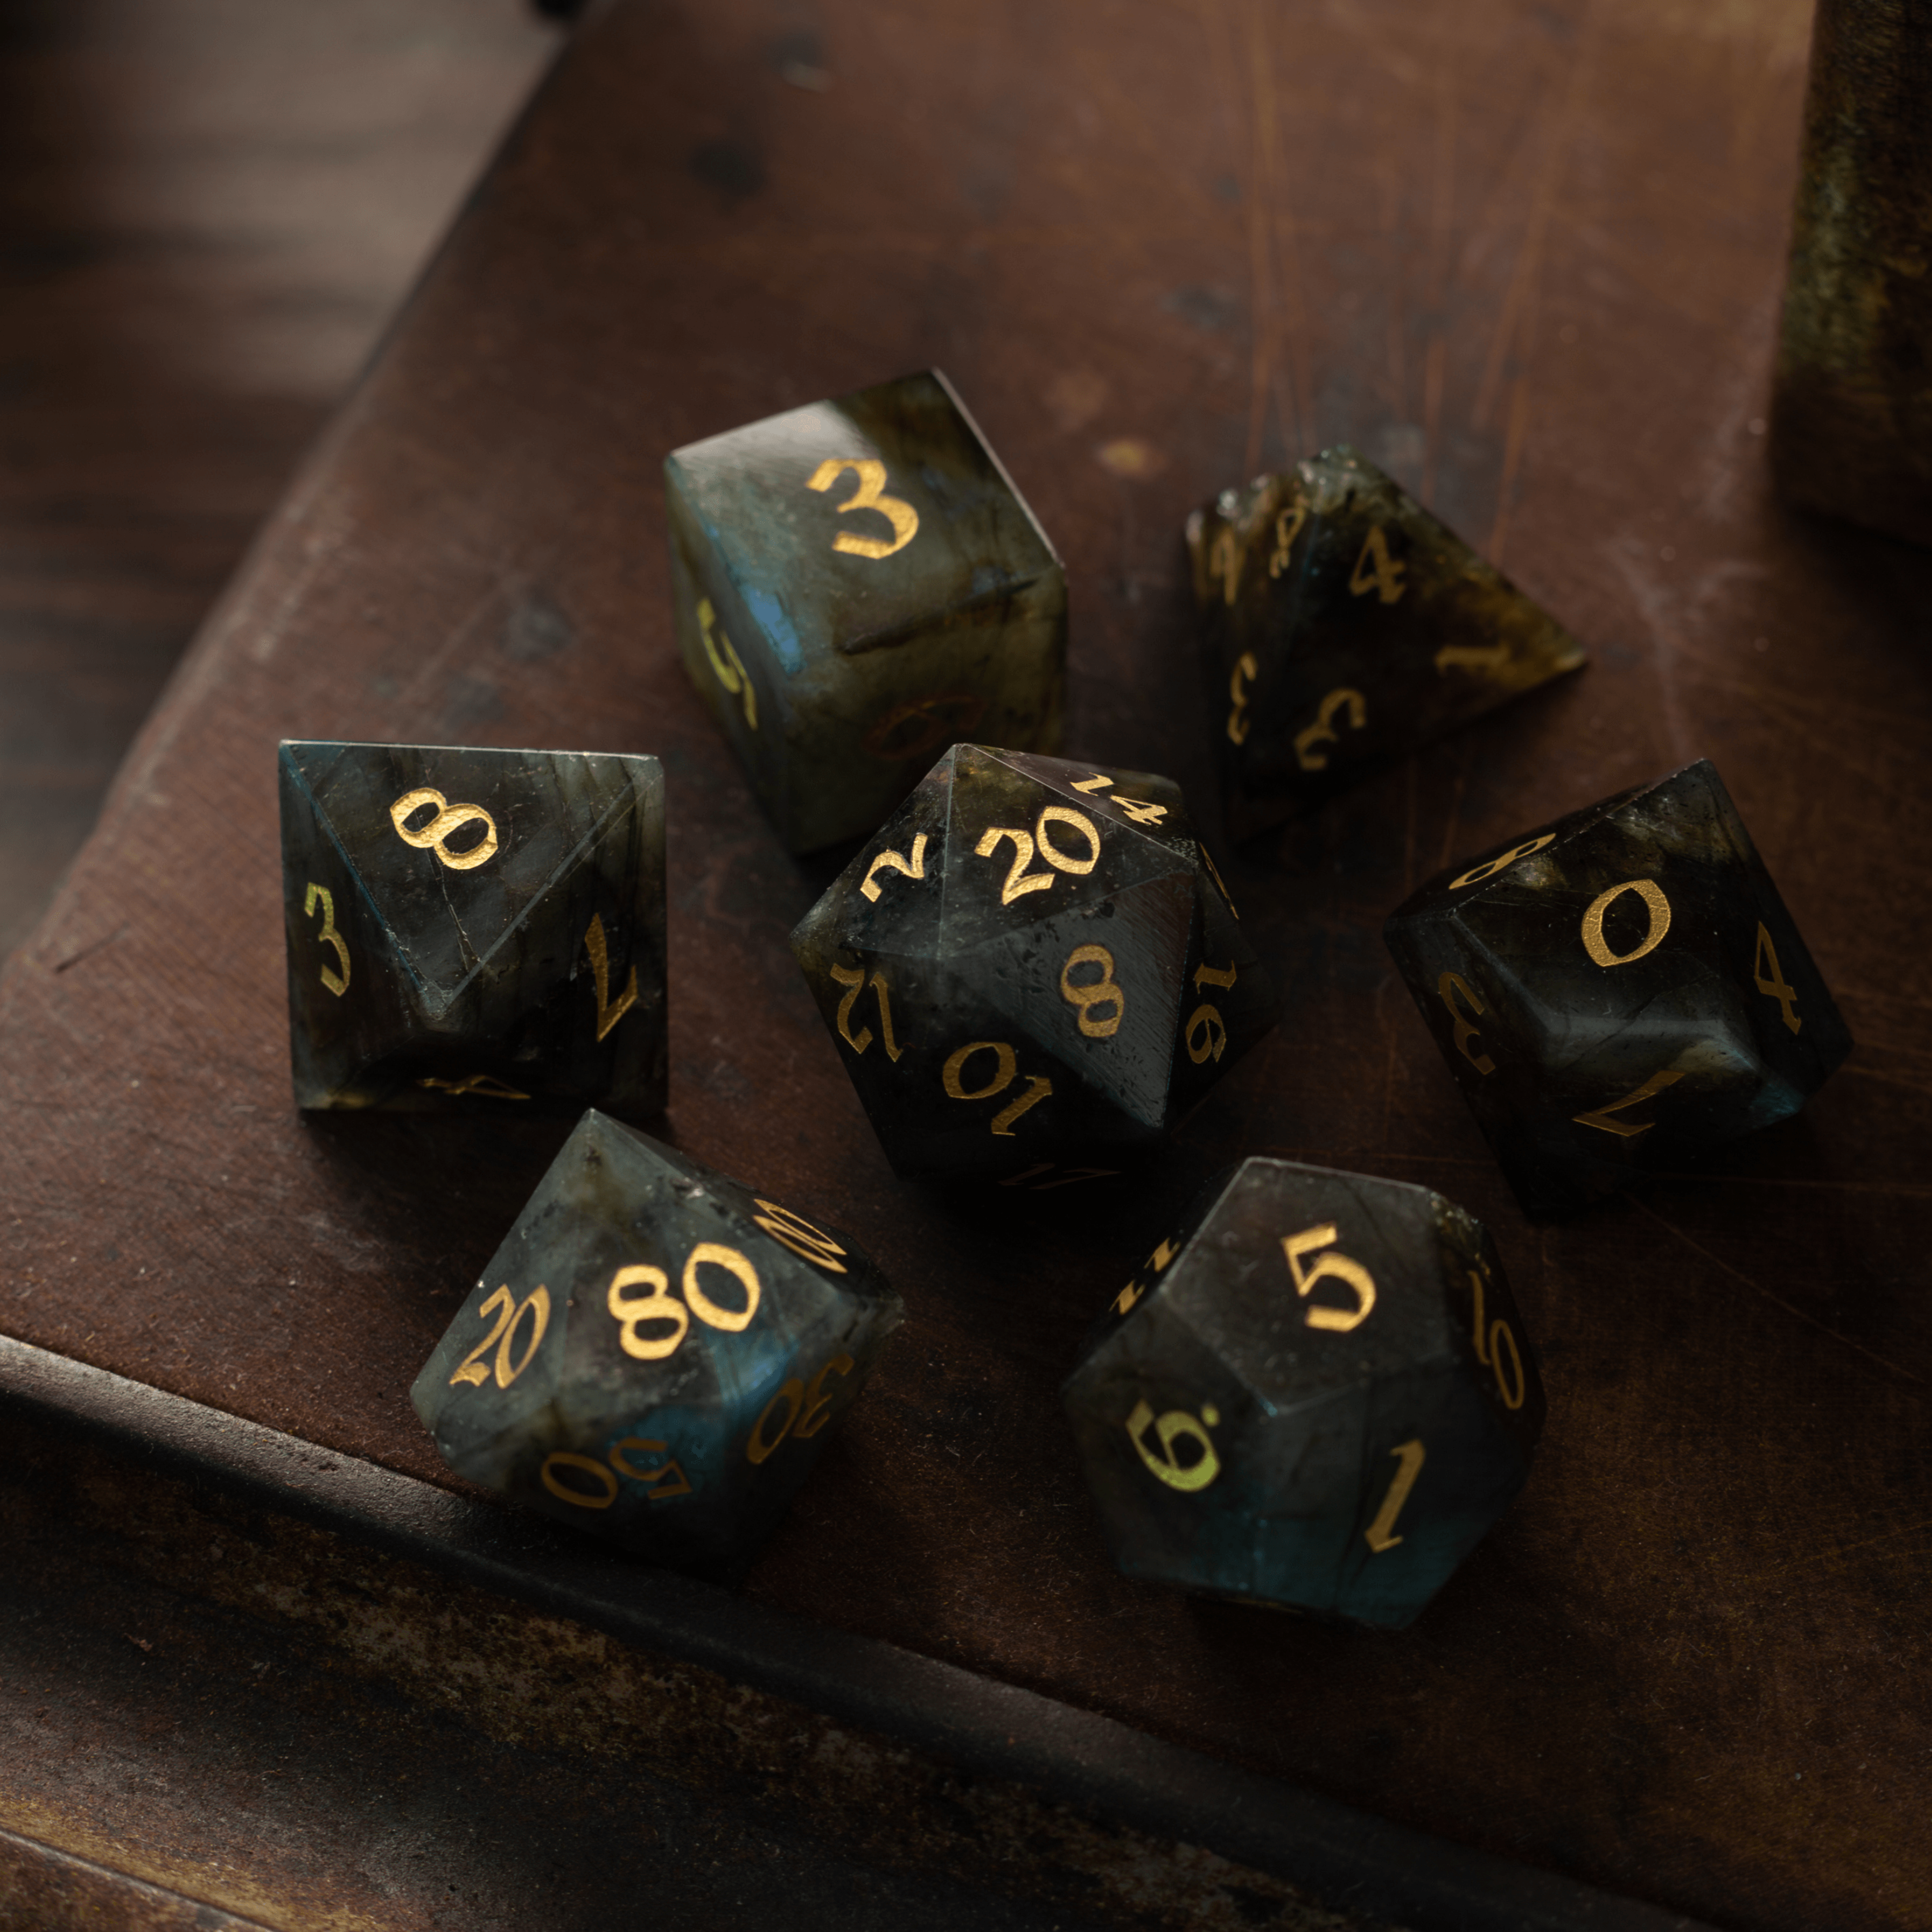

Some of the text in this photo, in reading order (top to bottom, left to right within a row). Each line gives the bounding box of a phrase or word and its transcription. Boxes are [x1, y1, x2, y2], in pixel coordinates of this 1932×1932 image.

[807, 460, 919, 559] 3
[1347, 525, 1407, 606] 4
[697, 597, 759, 731] 5
[1293, 687, 1368, 771] 3
[390, 787, 499, 871] 8
[1070, 771, 1169, 826] 14
[860, 832, 929, 903] 2
[974, 805, 1101, 906] 20
[1448, 832, 1557, 890] 8
[304, 882, 351, 997] 3
[1580, 878, 1672, 967] 0
[583, 912, 639, 1044] 7
[828, 963, 905, 1063] 12
[1060, 943, 1125, 1038] 8
[1185, 959, 1238, 1065] 16
[1437, 971, 1497, 1076] 3
[1753, 920, 1803, 1037] 4
[942, 1041, 1053, 1137] 10
[1571, 1069, 1686, 1138] 7
[607, 1241, 761, 1361] 80
[1280, 1221, 1377, 1333] 5
[448, 1283, 551, 1389] 20
[1467, 1270, 1525, 1411] 10
[745, 1353, 856, 1465] 30
[540, 1436, 692, 1510] 50
[1363, 1439, 1426, 1554] 1
